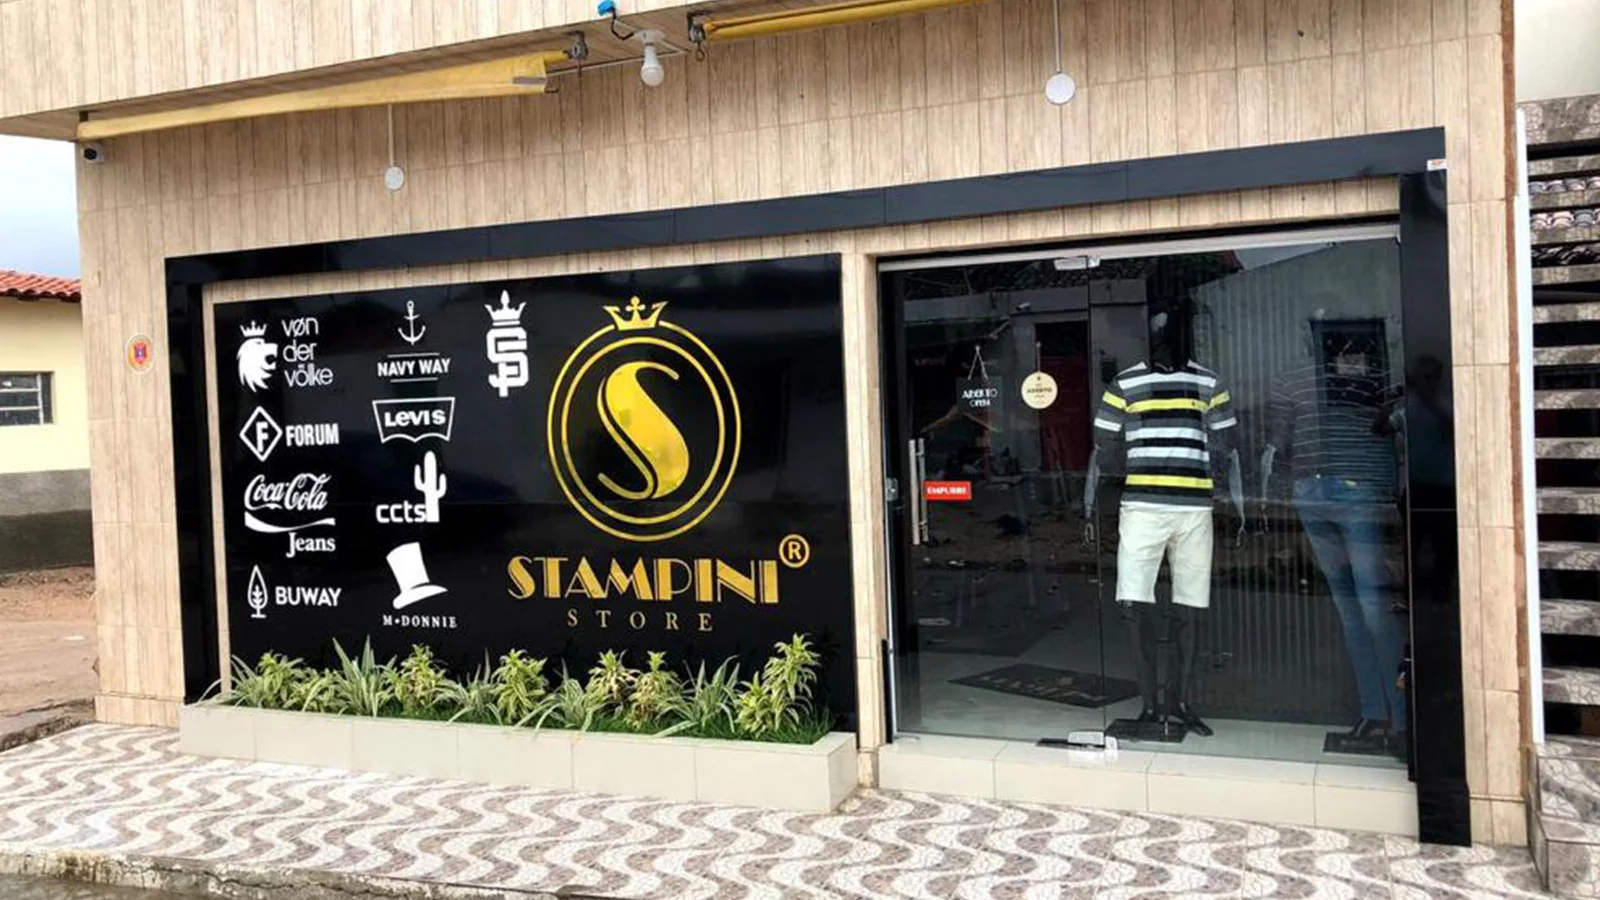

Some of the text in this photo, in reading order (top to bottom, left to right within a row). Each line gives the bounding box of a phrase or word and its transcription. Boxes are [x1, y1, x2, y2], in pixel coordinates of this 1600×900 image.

[282, 340, 317, 363] der
[284, 364, 333, 387] völke
[377, 358, 450, 377] NAVY WAY
[285, 423, 339, 446] FORUM
[244, 473, 331, 511] Coca-Cola
[376, 501, 427, 523] ccts
[286, 532, 336, 557] Jeans
[507, 556, 779, 604] STAMPINI
[275, 587, 341, 606] BUWAY
[567, 609, 713, 631] STORE
